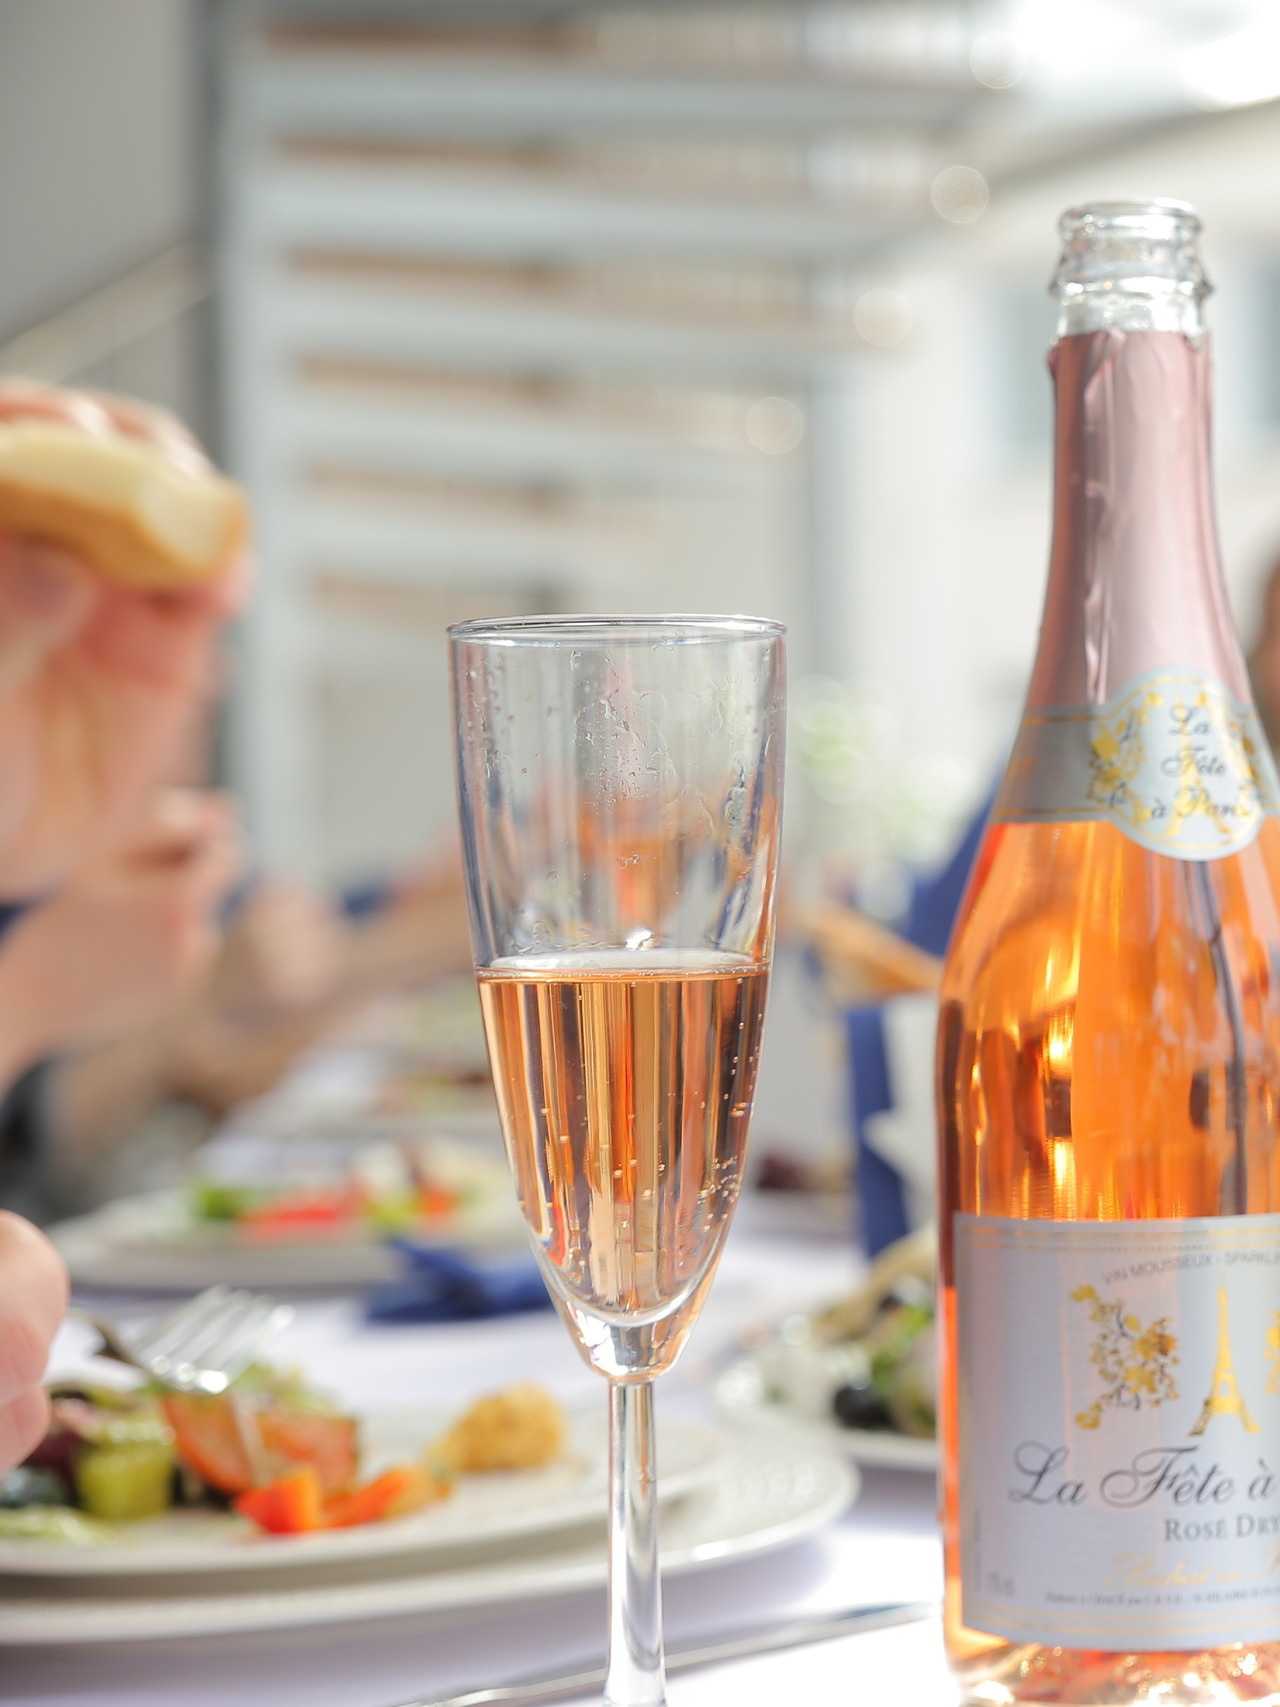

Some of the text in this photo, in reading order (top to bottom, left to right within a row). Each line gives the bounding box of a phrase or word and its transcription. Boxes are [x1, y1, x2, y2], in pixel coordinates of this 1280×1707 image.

[1102, 1268, 1130, 1286] VIN
[1129, 1254, 1214, 1279] MOUSSEUX
[1009, 1440, 1088, 1508] La
[1099, 1444, 1236, 1509] Fête
[1248, 1457, 1277, 1501] à
